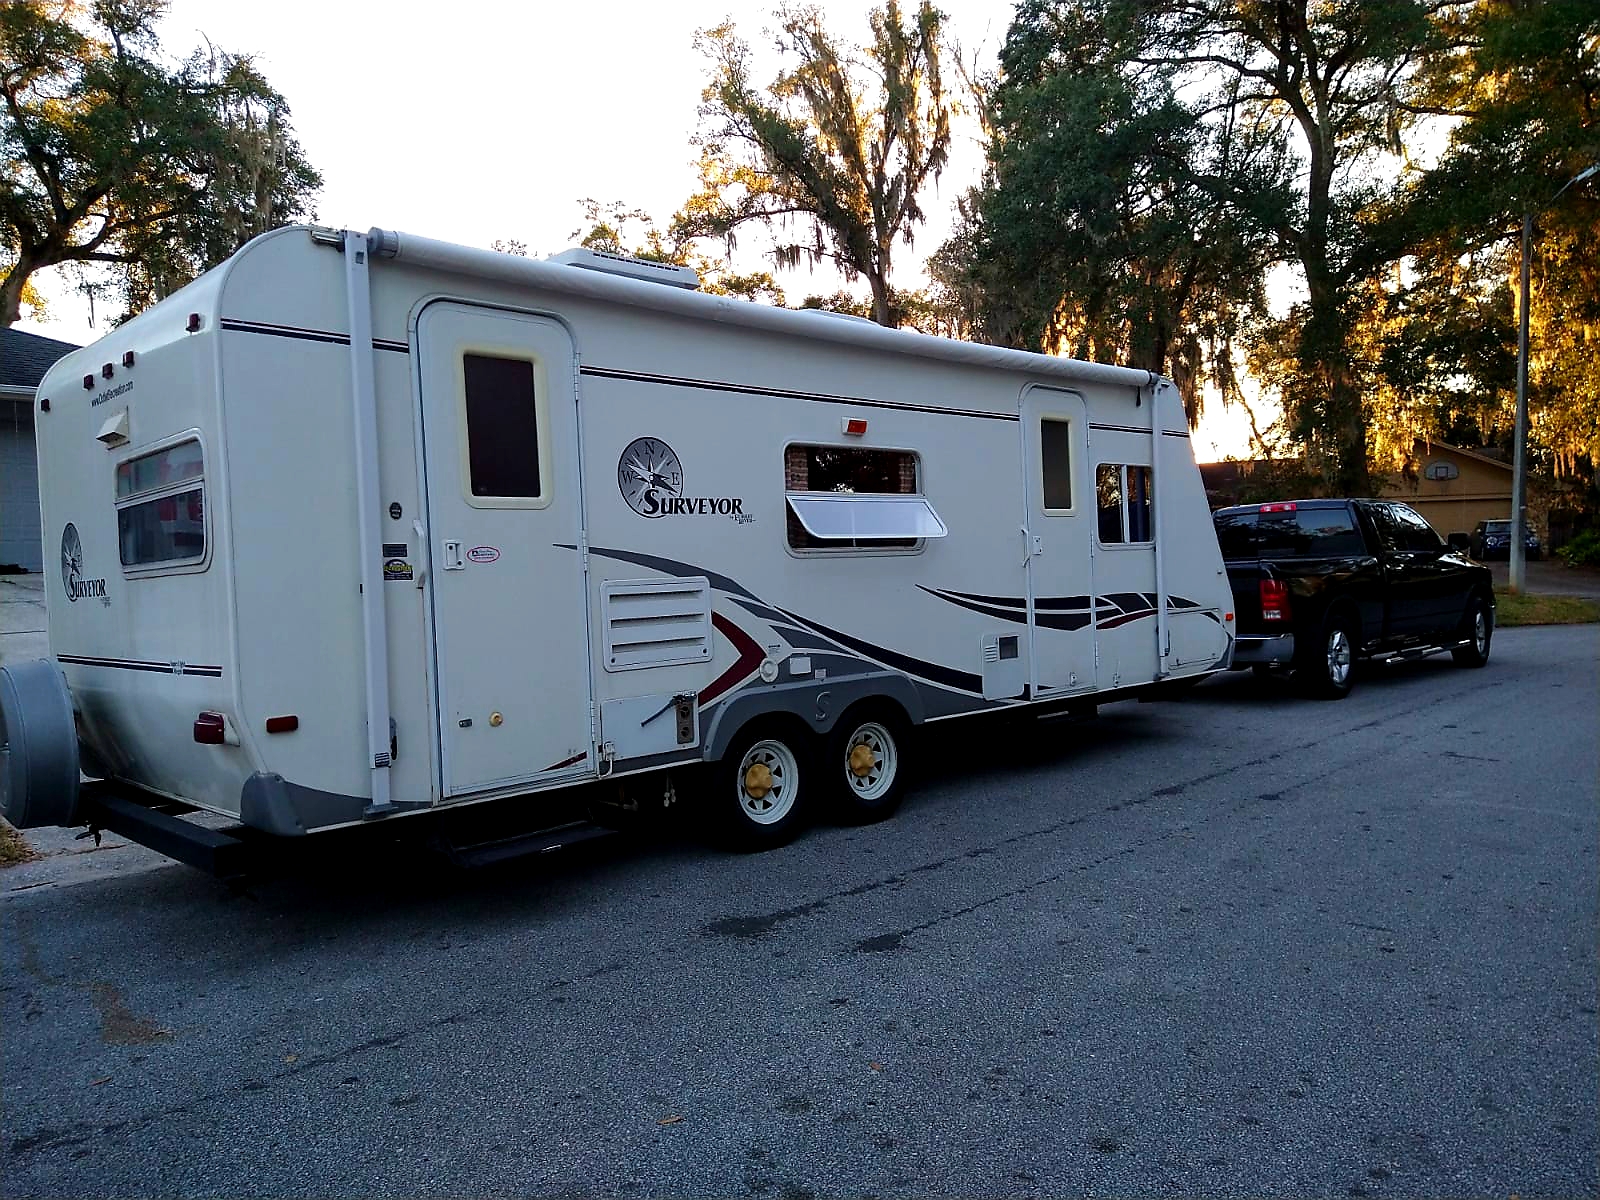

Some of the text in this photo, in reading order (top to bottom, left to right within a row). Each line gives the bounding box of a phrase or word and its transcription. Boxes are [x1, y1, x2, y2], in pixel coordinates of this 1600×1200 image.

[645, 441, 655, 455] N
[621, 470, 681, 486] W E
